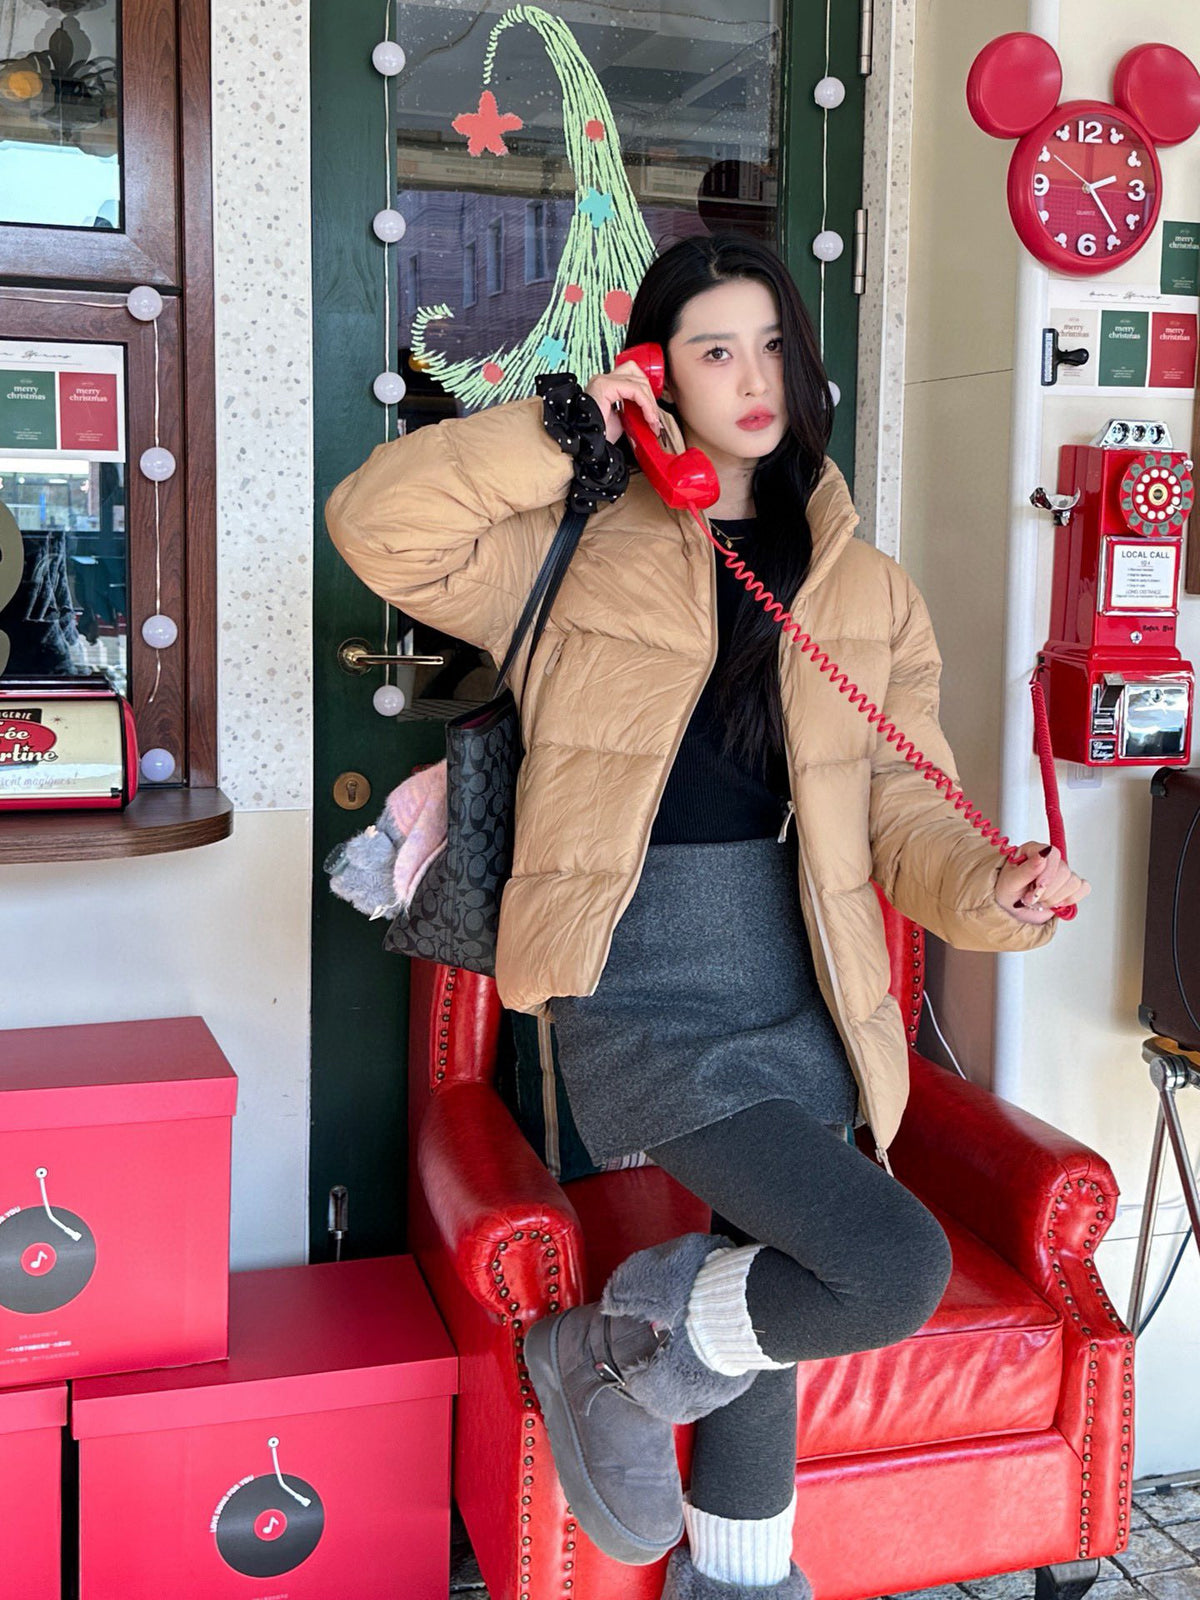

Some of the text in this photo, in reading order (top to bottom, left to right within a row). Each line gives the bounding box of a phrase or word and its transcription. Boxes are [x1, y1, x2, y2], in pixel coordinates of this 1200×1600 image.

[1078, 120, 1103, 143] 12
[1034, 174, 1050, 196] 9
[1128, 179, 1146, 201] 3
[1174, 235, 1196, 244] merry
[1077, 233, 1097, 256] 6
[1169, 241, 1200, 249] christmas
[1063, 324, 1083, 332] merry
[1114, 325, 1136, 334] merry
[1165, 327, 1185, 336] merry
[1108, 331, 1141, 340] christmas
[1159, 333, 1190, 341] christmas
[13, 385, 39, 394] merry
[76, 388, 101, 396] merry
[6, 391, 46, 400] christmas
[69, 394, 108, 402] christmas
[1121, 551, 1170, 559] LOCAL CALL
[0, 711, 32, 720] GERIE
